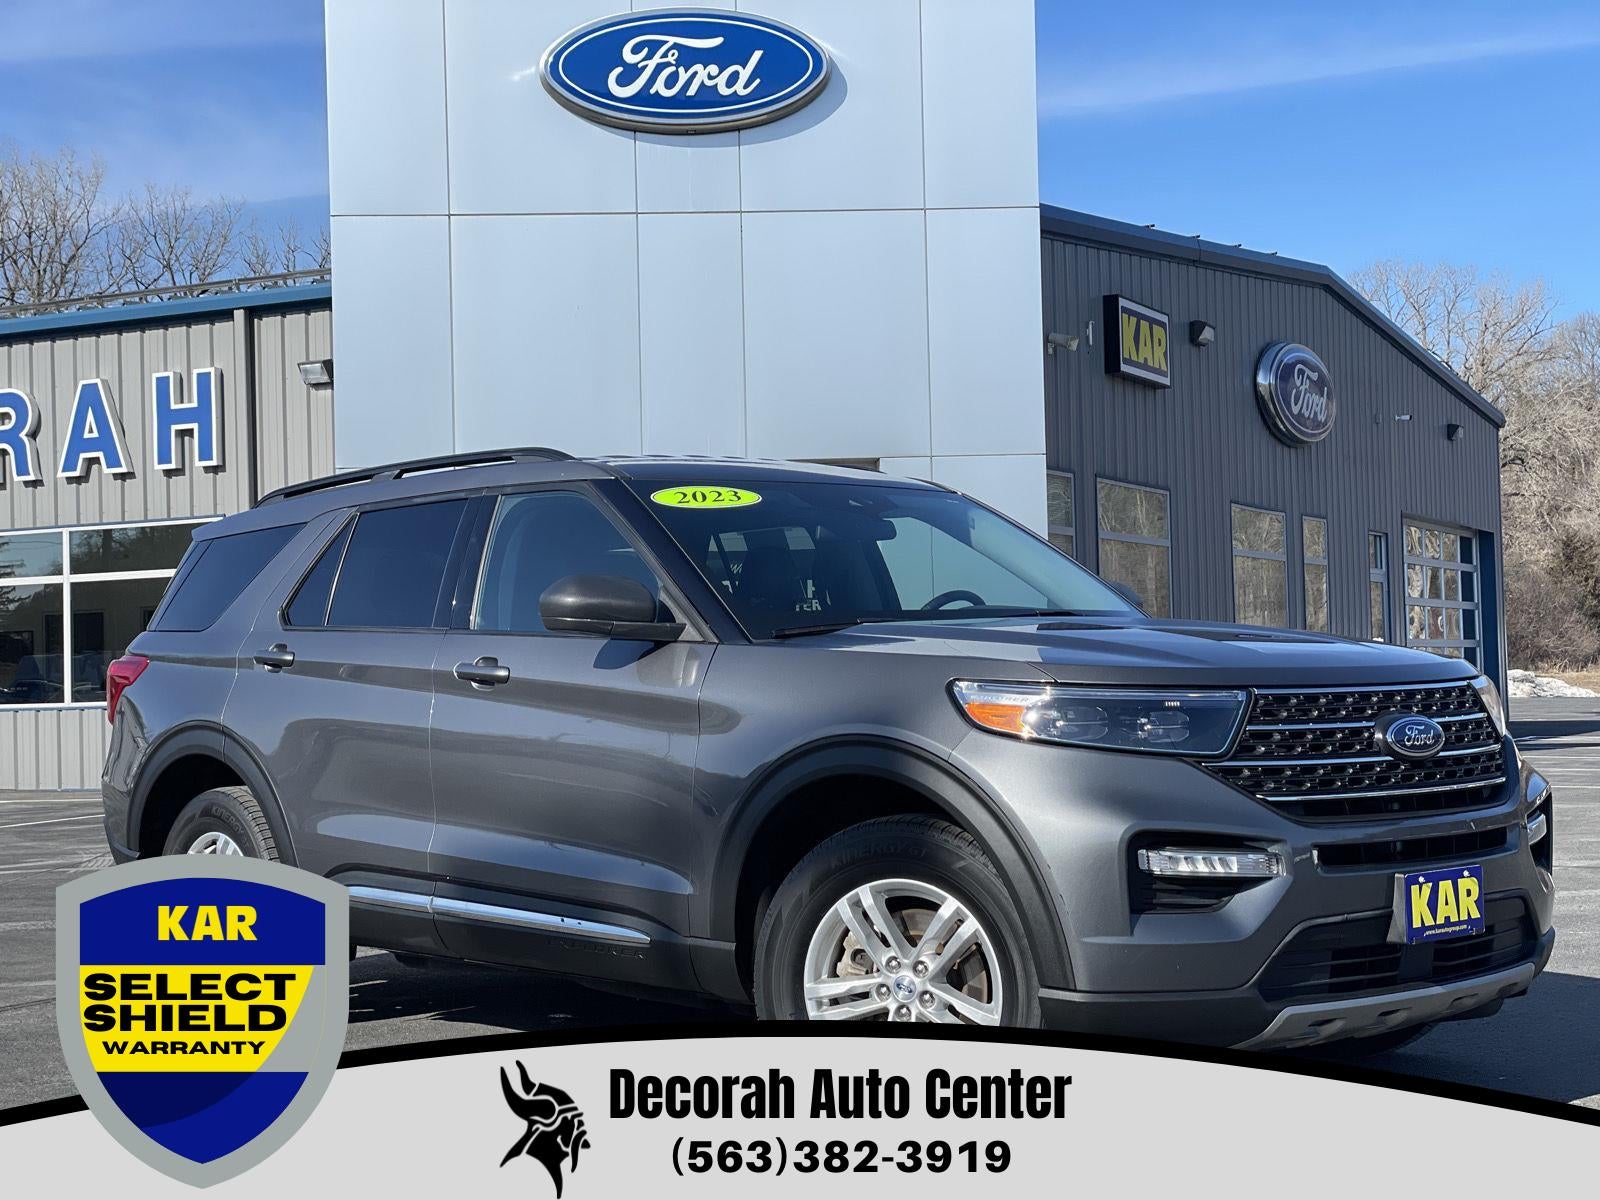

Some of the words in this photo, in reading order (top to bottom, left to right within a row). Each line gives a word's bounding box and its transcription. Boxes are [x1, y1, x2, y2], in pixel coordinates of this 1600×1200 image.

[607, 34, 764, 98] Ford
[1121, 312, 1167, 372] KAR
[1290, 363, 1329, 423] Ford
[672, 489, 743, 504] 2023
[1404, 724, 1436, 747] Ford
[1410, 875, 1481, 929] KAR
